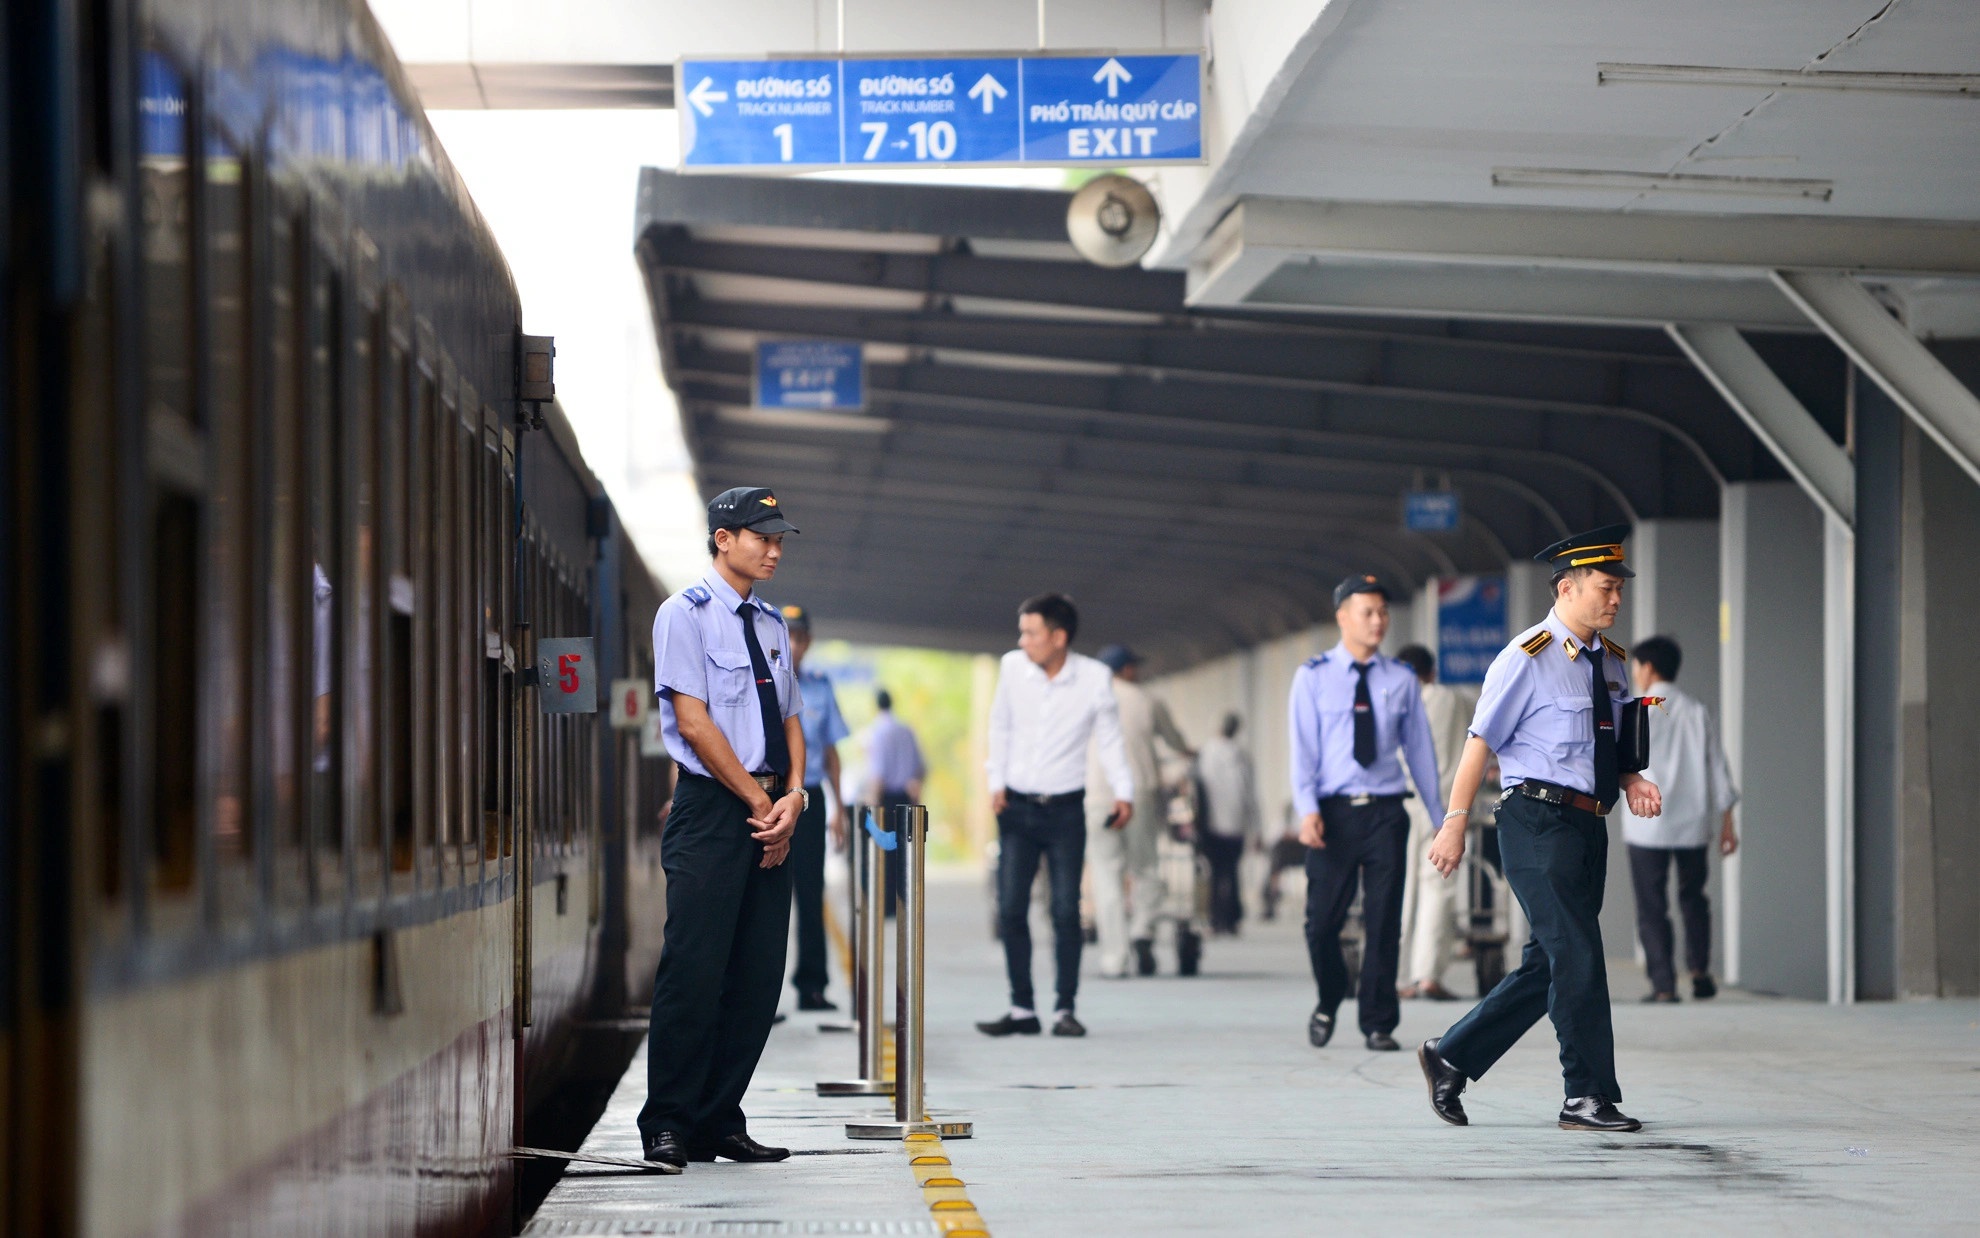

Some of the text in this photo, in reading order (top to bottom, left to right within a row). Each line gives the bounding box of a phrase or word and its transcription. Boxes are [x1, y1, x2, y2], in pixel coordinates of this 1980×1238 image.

[736, 74, 832, 98] ĐƯỜNG SỐ
[859, 72, 954, 96] ĐƯỜNG SỐ
[737, 102, 832, 115] TRACK NUMBER
[861, 100, 955, 114] TRACK NUMBER
[1030, 99, 1070, 122] PHỐ
[1121, 100, 1158, 121] QUÝ
[1160, 100, 1197, 120] CÁP
[773, 123, 793, 162] 1
[1068, 127, 1158, 157] EXIT
[558, 654, 581, 693] 5
